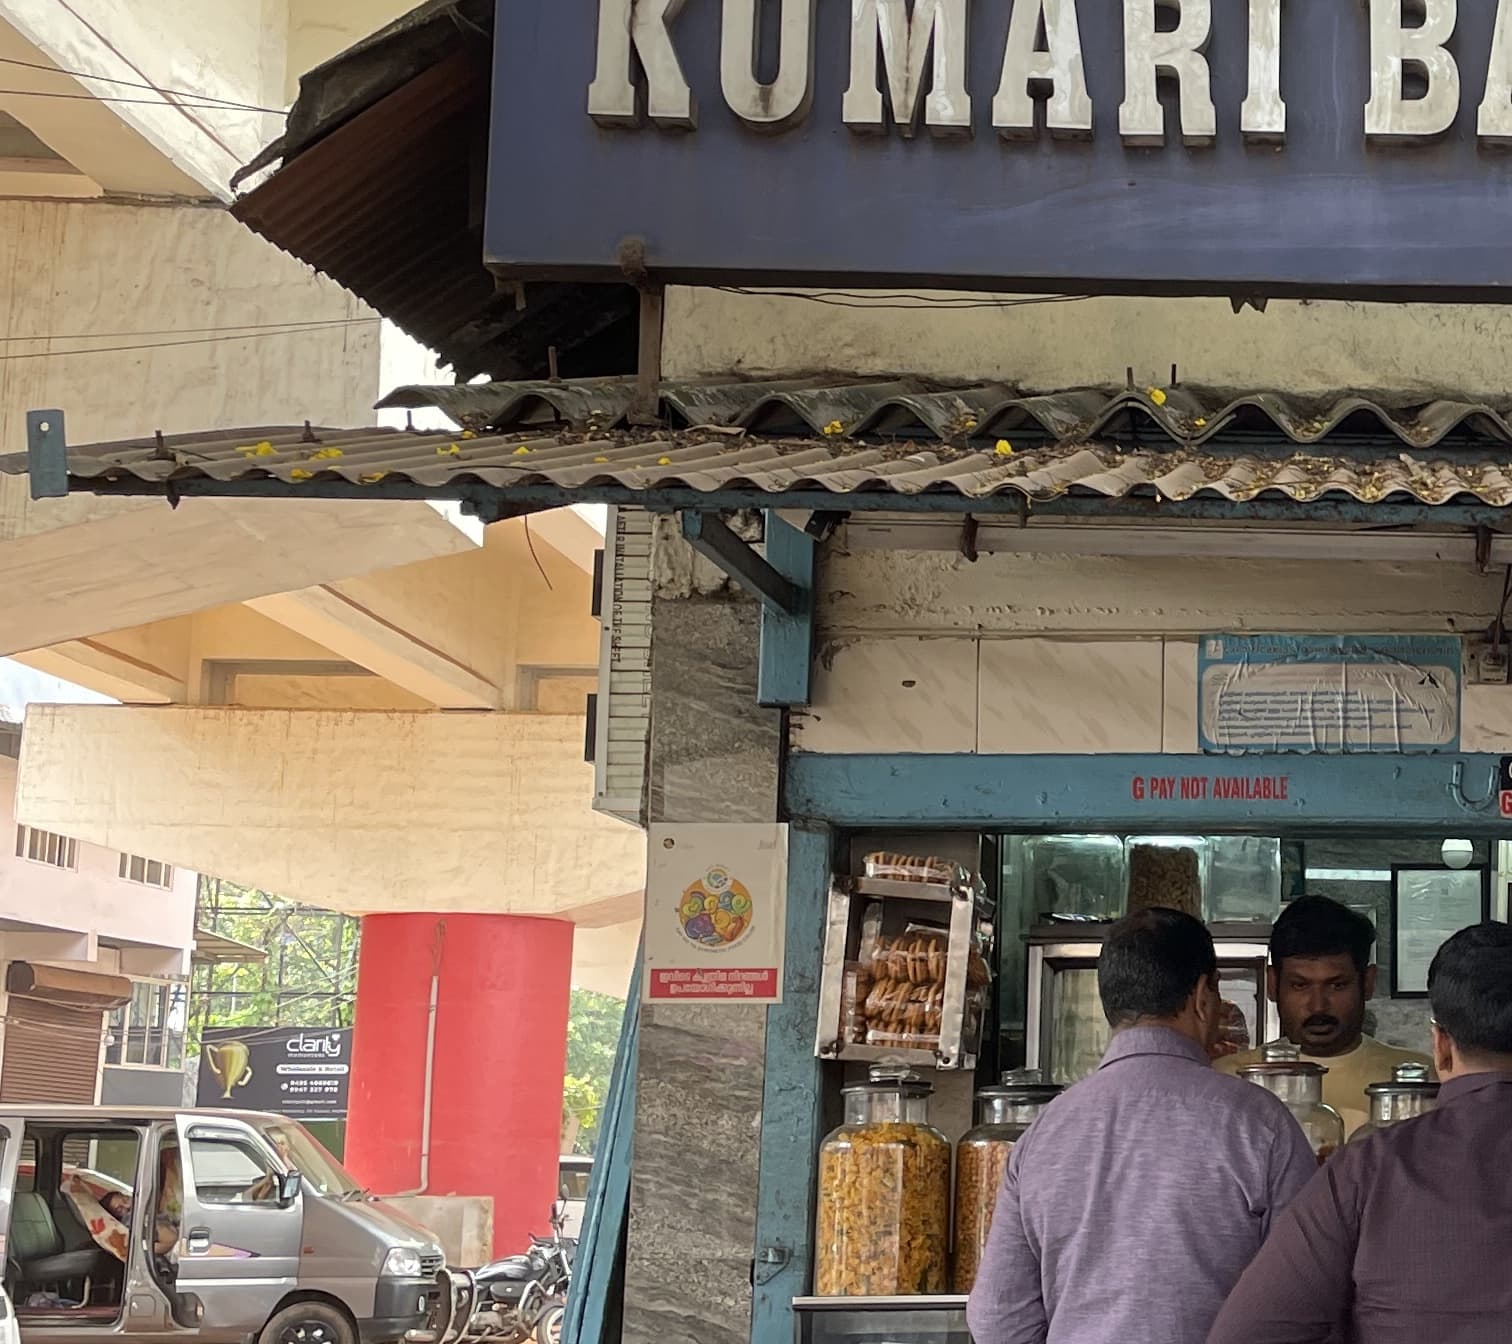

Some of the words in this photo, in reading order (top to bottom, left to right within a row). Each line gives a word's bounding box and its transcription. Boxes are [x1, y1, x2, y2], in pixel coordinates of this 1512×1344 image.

[1132, 776, 1145, 800] G
[1150, 776, 1177, 800] PAY
[1180, 776, 1209, 800] NOT
[1212, 776, 1289, 800] AVAILABLE
[286, 1032, 341, 1057] clarity
